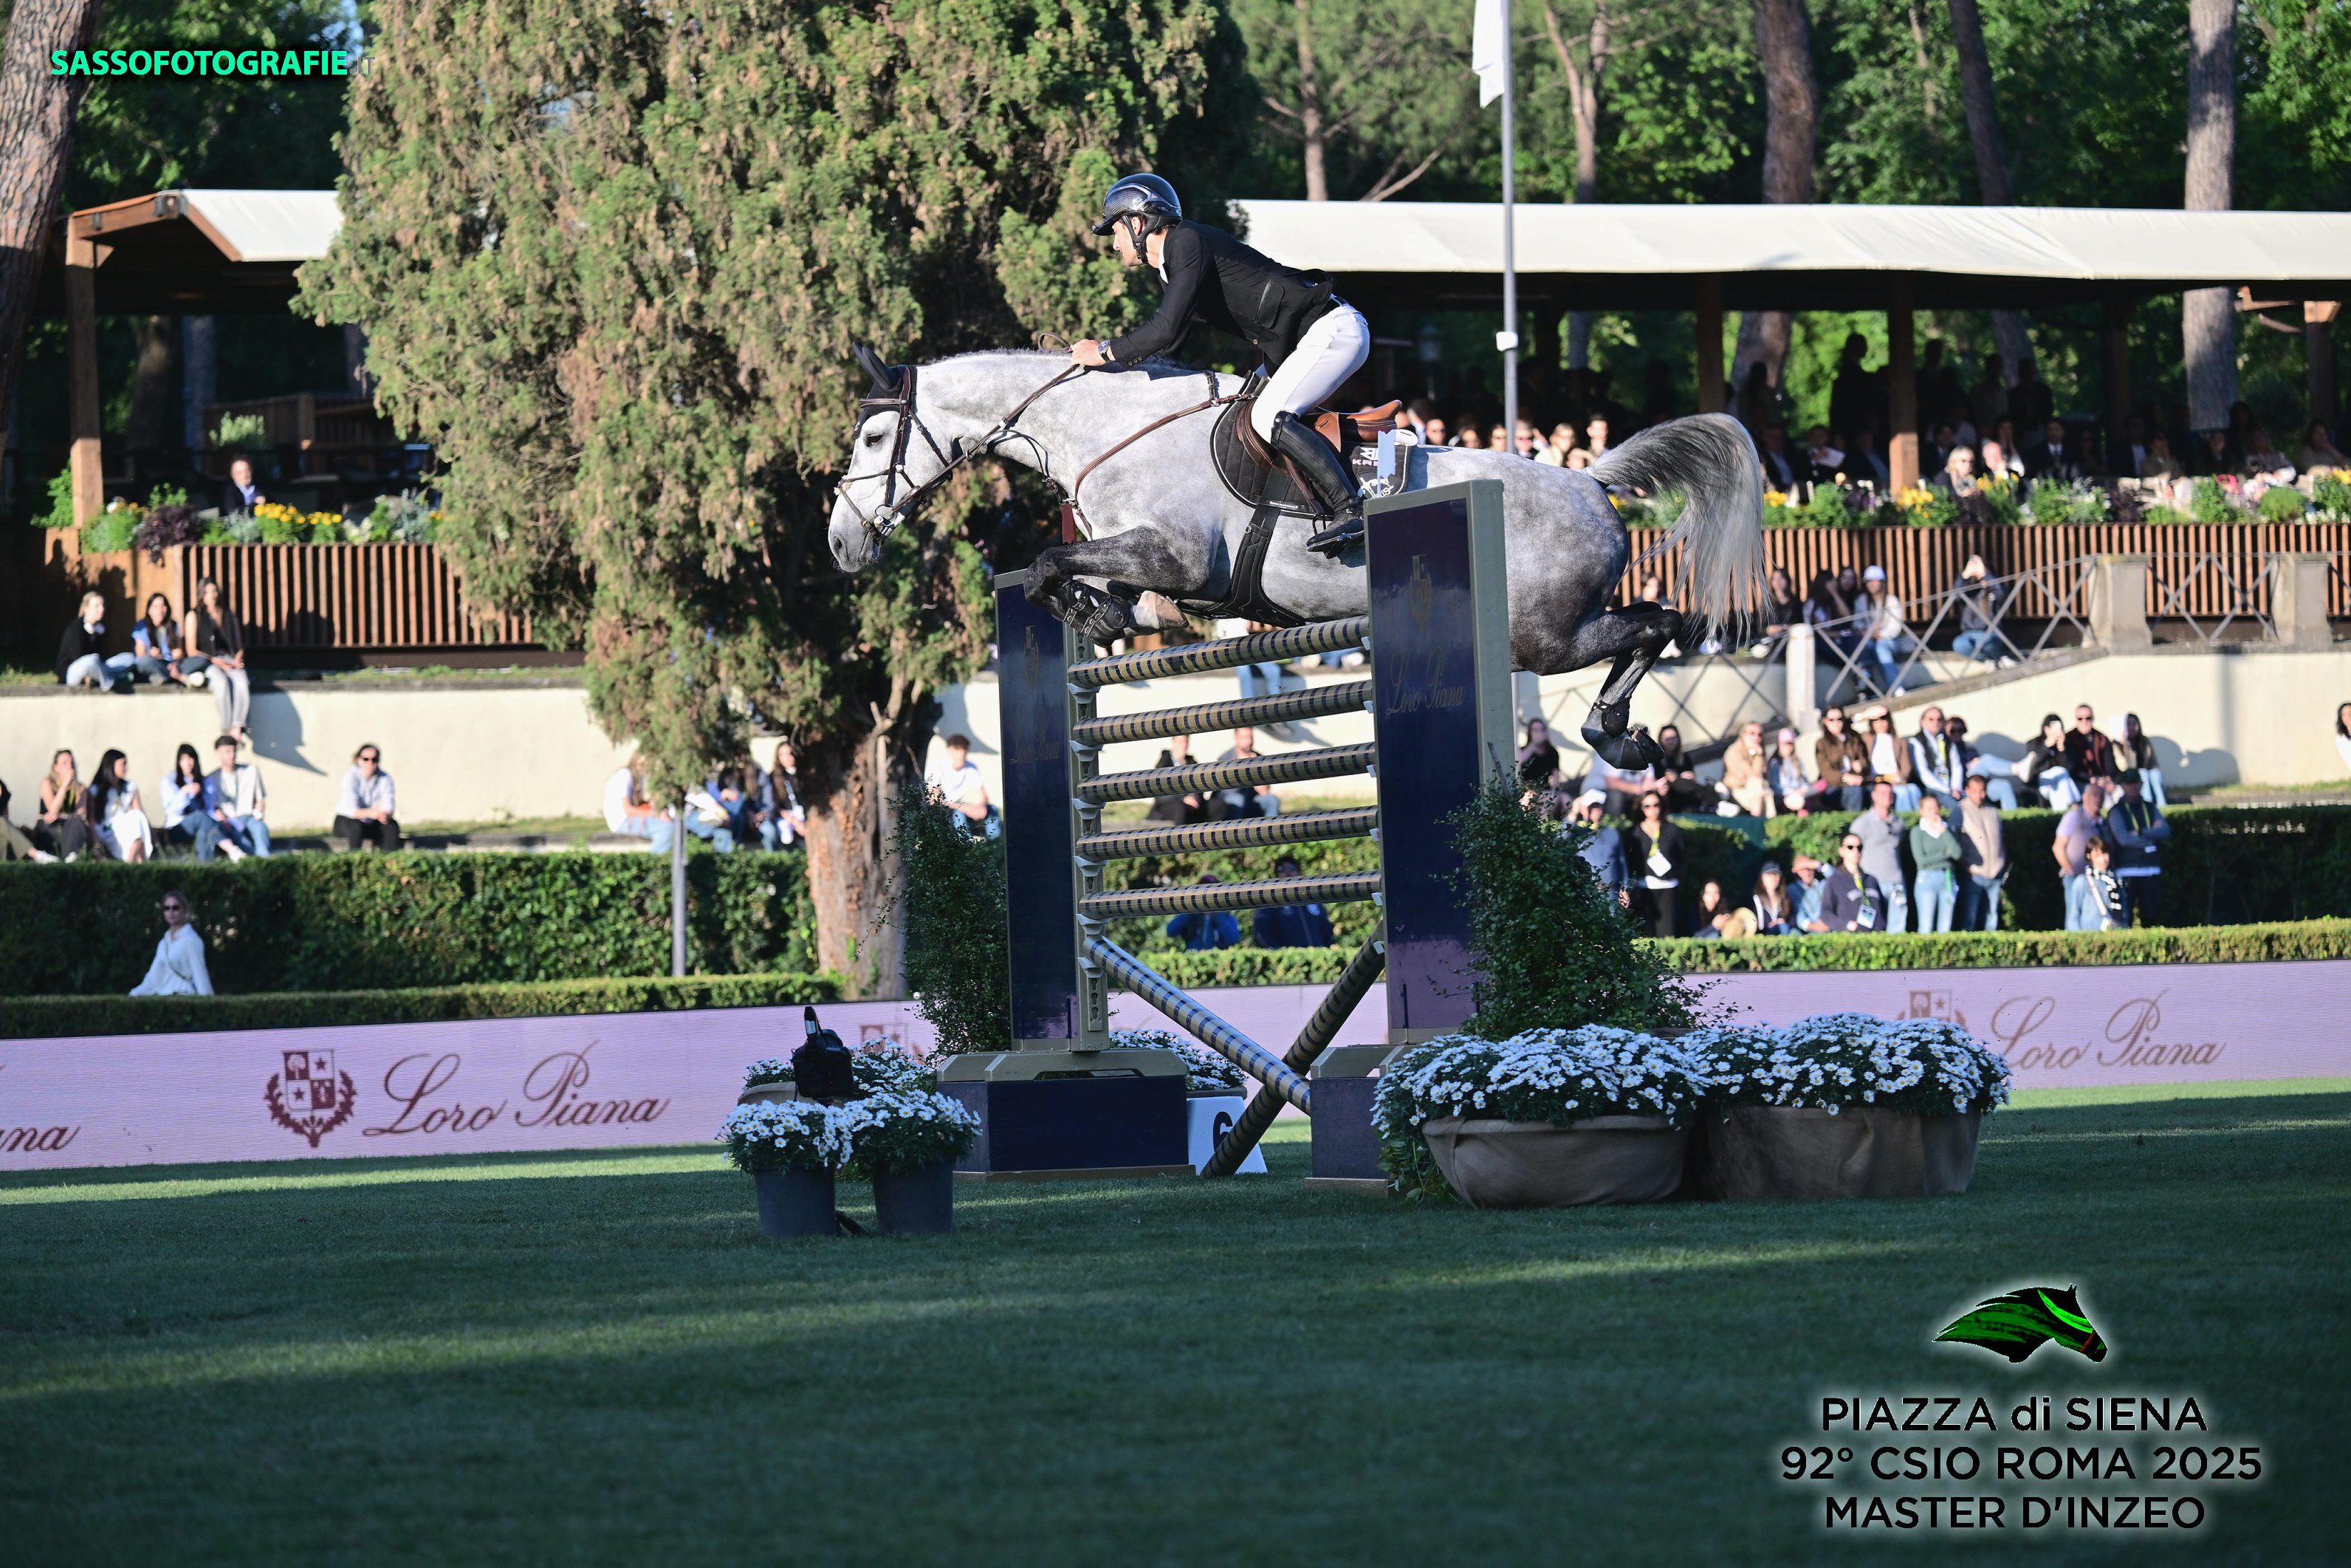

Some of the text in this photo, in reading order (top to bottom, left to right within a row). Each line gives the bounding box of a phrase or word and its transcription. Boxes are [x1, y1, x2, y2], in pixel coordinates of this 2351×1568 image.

[1991, 987, 2227, 1070] Loro Piana
[363, 1039, 670, 1136] Loro Piana
